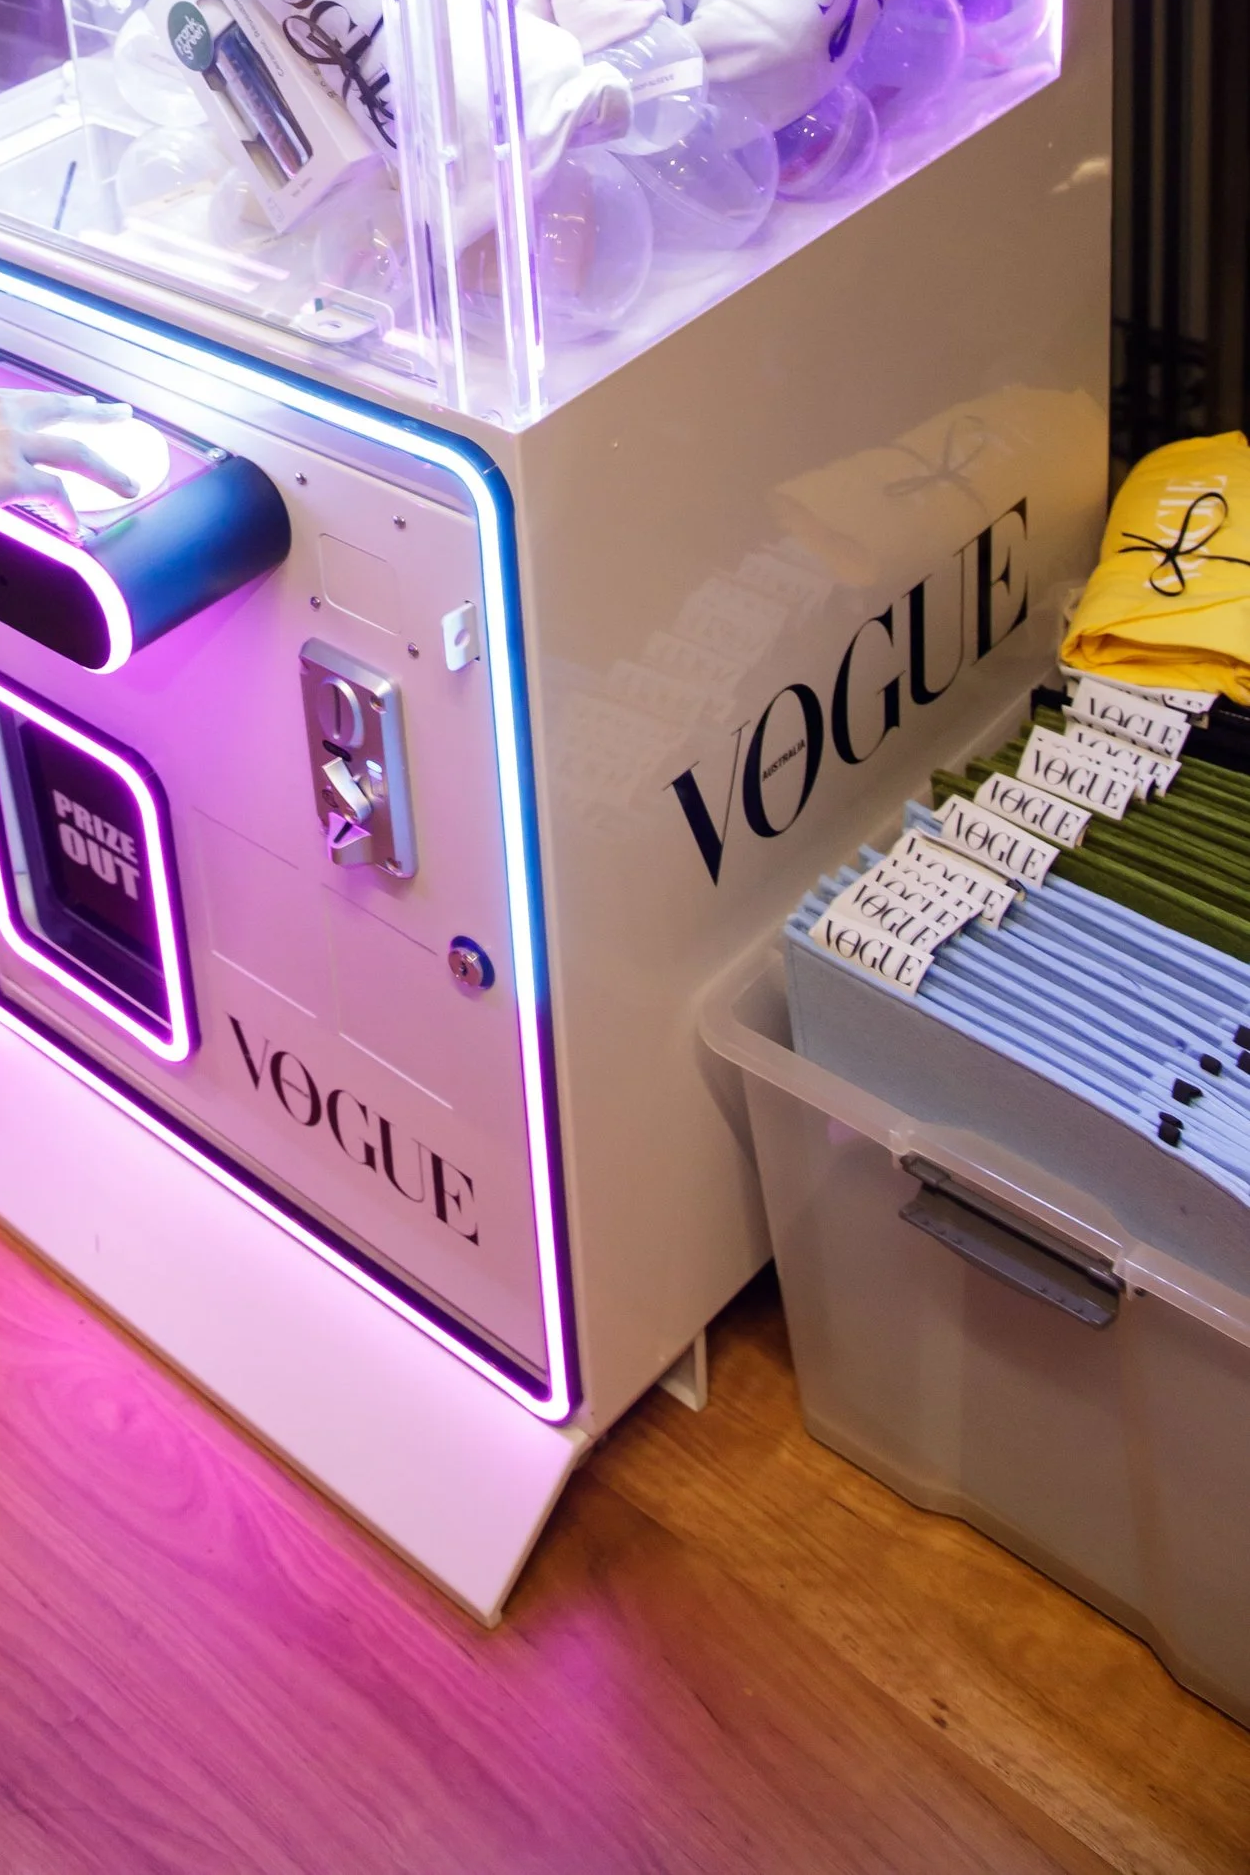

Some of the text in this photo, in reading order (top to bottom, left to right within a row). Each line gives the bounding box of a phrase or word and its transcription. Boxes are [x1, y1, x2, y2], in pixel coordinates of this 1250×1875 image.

[662, 496, 1029, 887] VOGUE
[762, 738, 806, 782] AUSTRALIA
[1033, 749, 1128, 811] VOGUE
[52, 788, 139, 865] PRIZE
[953, 810, 1047, 882] VOGUE
[989, 779, 1081, 842] VOGUE
[58, 822, 141, 902] OUT
[826, 918, 924, 988] VOGUE
[851, 884, 942, 953] VOGUE
[226, 1012, 480, 1247] VOGUE
